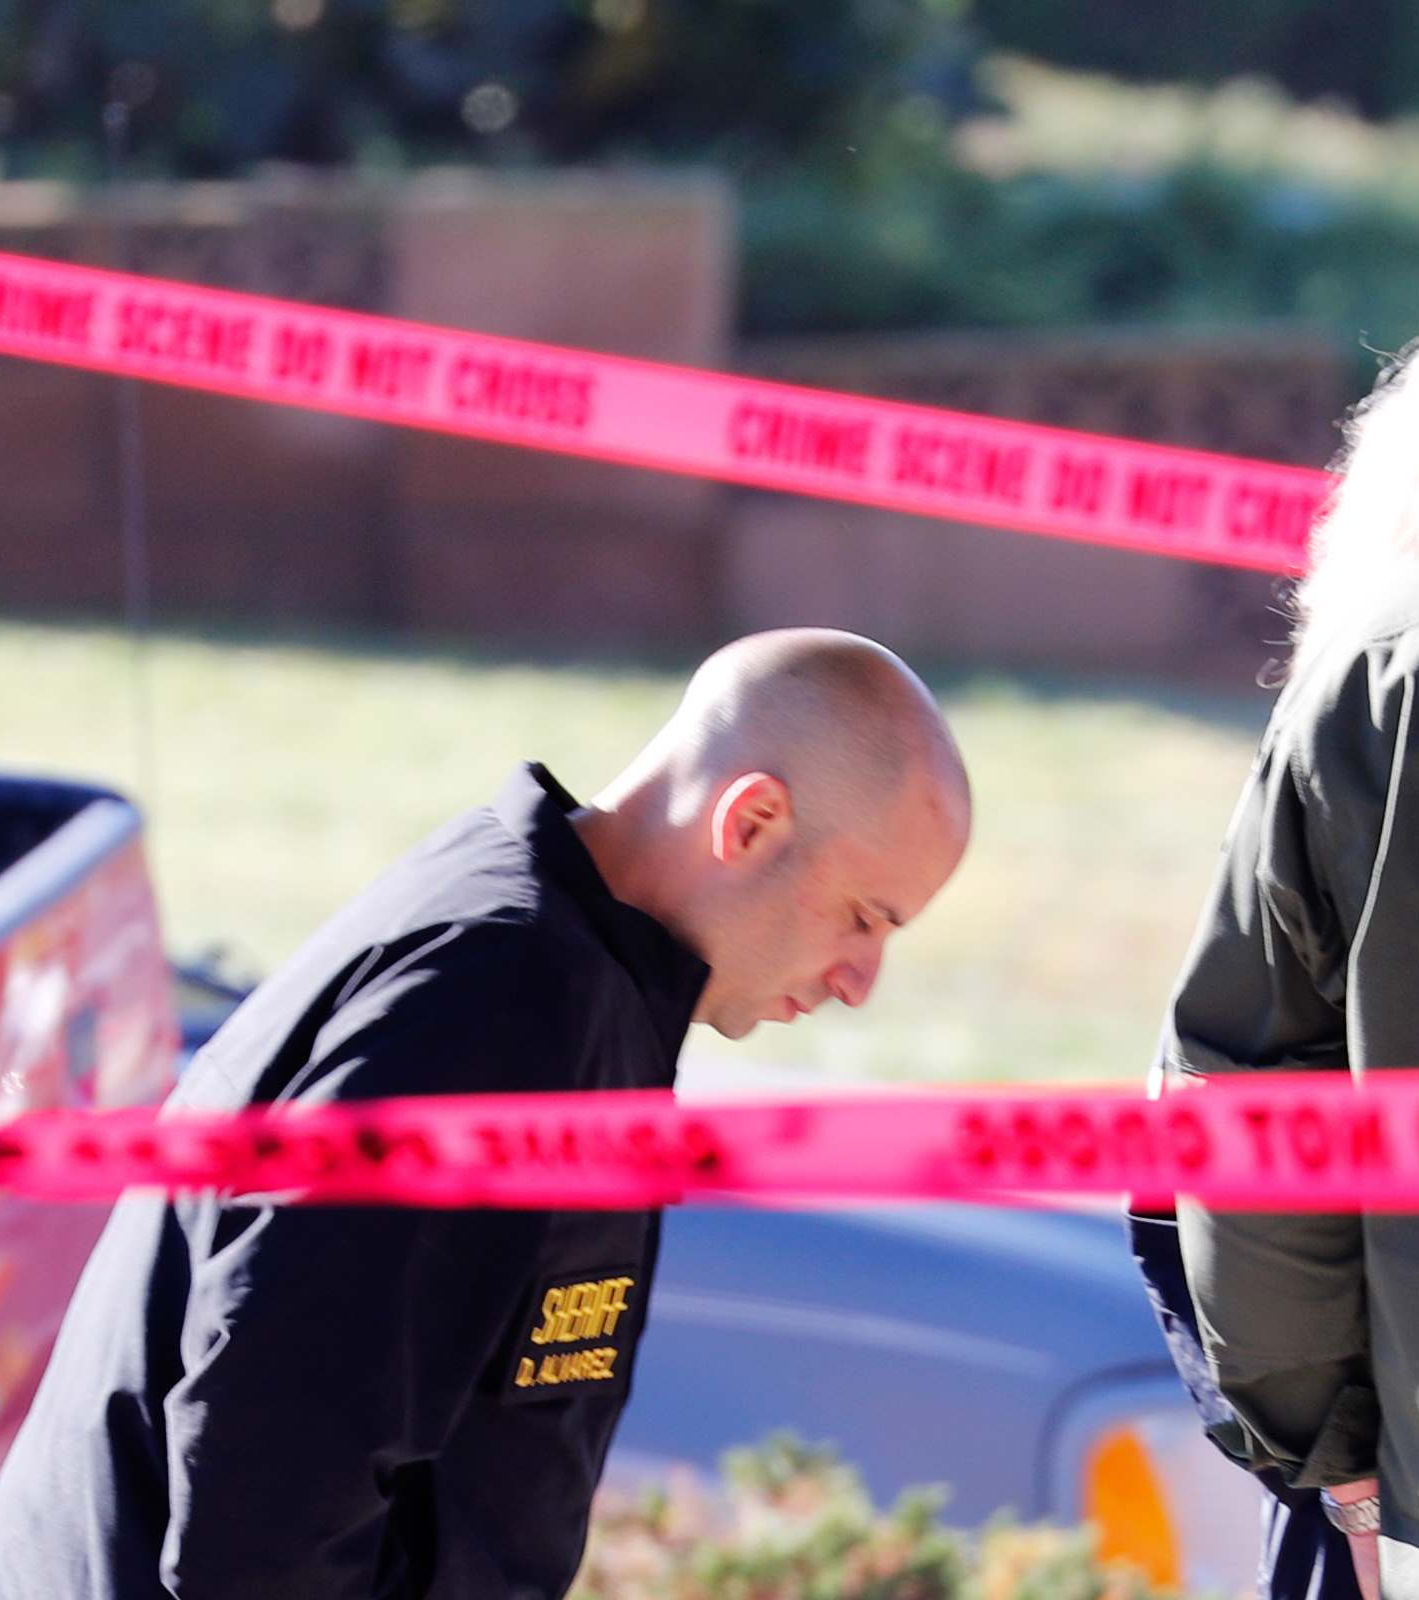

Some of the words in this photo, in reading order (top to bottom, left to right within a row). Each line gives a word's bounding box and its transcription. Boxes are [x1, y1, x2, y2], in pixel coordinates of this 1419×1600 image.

[116, 295, 252, 374] SCENE
[272, 322, 328, 386] DO
[348, 342, 432, 400] NOT
[450, 352, 594, 432] CROSS
[727, 400, 874, 482] CRIME
[893, 422, 1031, 508] SCENE
[1052, 457, 1106, 517] DO
[1131, 471, 1213, 530] NOT
